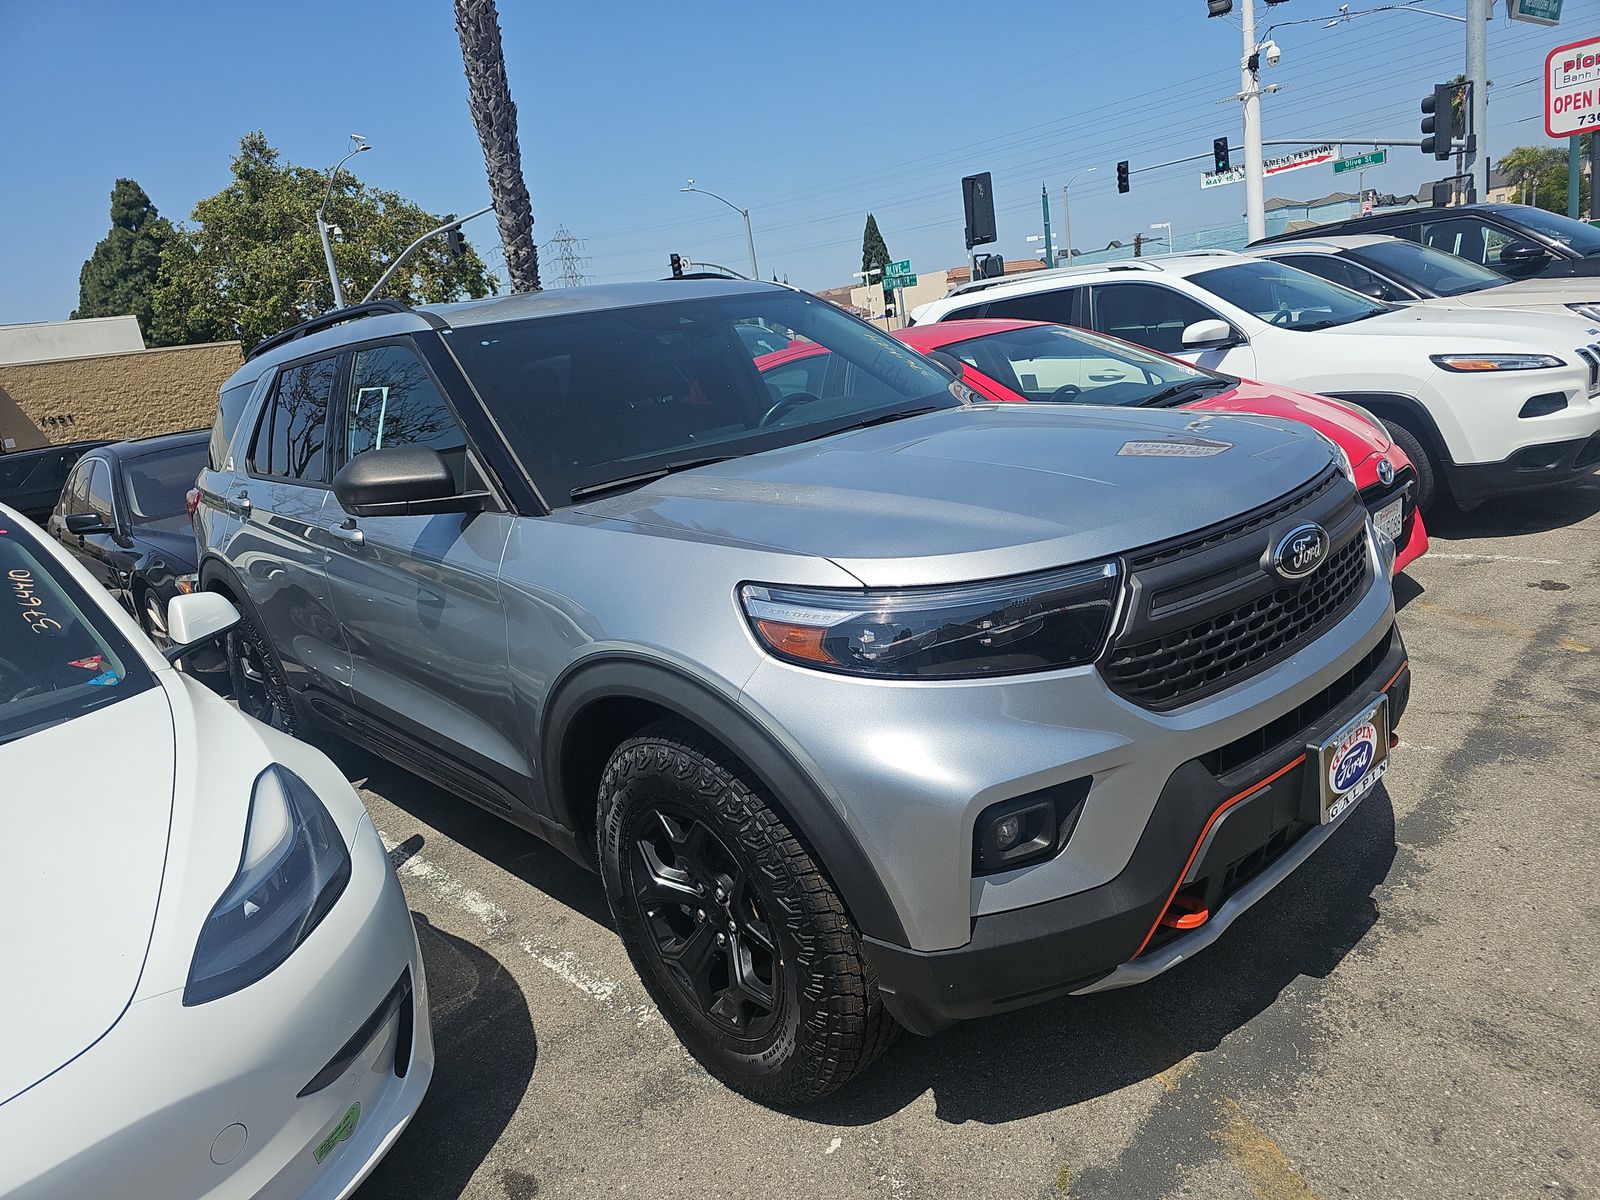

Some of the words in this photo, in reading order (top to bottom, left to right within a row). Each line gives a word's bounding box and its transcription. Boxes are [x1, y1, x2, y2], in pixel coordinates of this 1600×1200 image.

[1563, 70, 1591, 84] Banh
[1554, 89, 1592, 114] OPEN
[1293, 145, 1334, 160] FESTIVAL
[1344, 159, 1362, 168] Olive
[1364, 155, 1372, 163] St
[1205, 177, 1222, 186] MAY
[885, 263, 902, 276] OLIVE
[1293, 535, 1320, 569] Ford
[760, 607, 831, 621] EXPLORER
[1331, 726, 1374, 770] GALPIN
[1337, 743, 1369, 788] Ford
[1330, 761, 1387, 819] GALPIN
